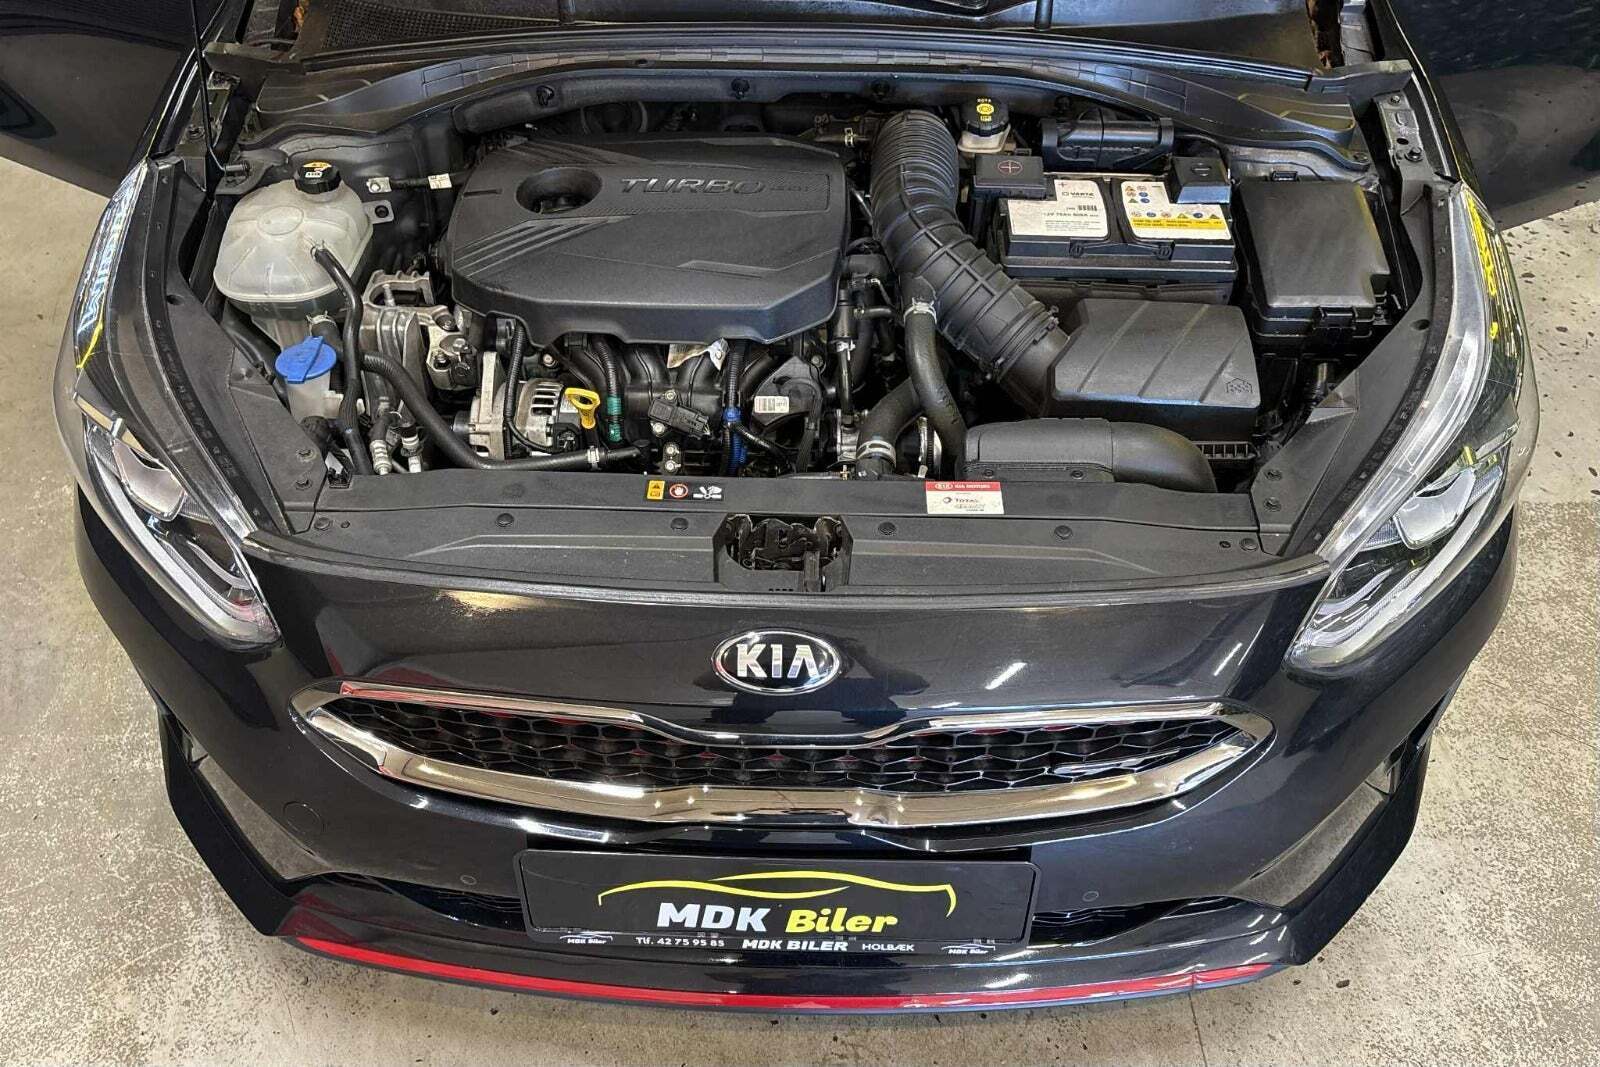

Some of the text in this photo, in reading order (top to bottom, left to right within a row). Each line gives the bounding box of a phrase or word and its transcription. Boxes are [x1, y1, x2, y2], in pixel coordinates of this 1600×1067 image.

[621, 177, 766, 195] TURBO
[736, 643, 819, 679] KIA
[656, 902, 898, 934] MDK Biler
[636, 936, 654, 945] Tlf.
[657, 937, 672, 945] 42
[674, 937, 690, 946] 75
[692, 939, 707, 947] 95
[742, 938, 915, 952] MDK BILER HOLBÆK
